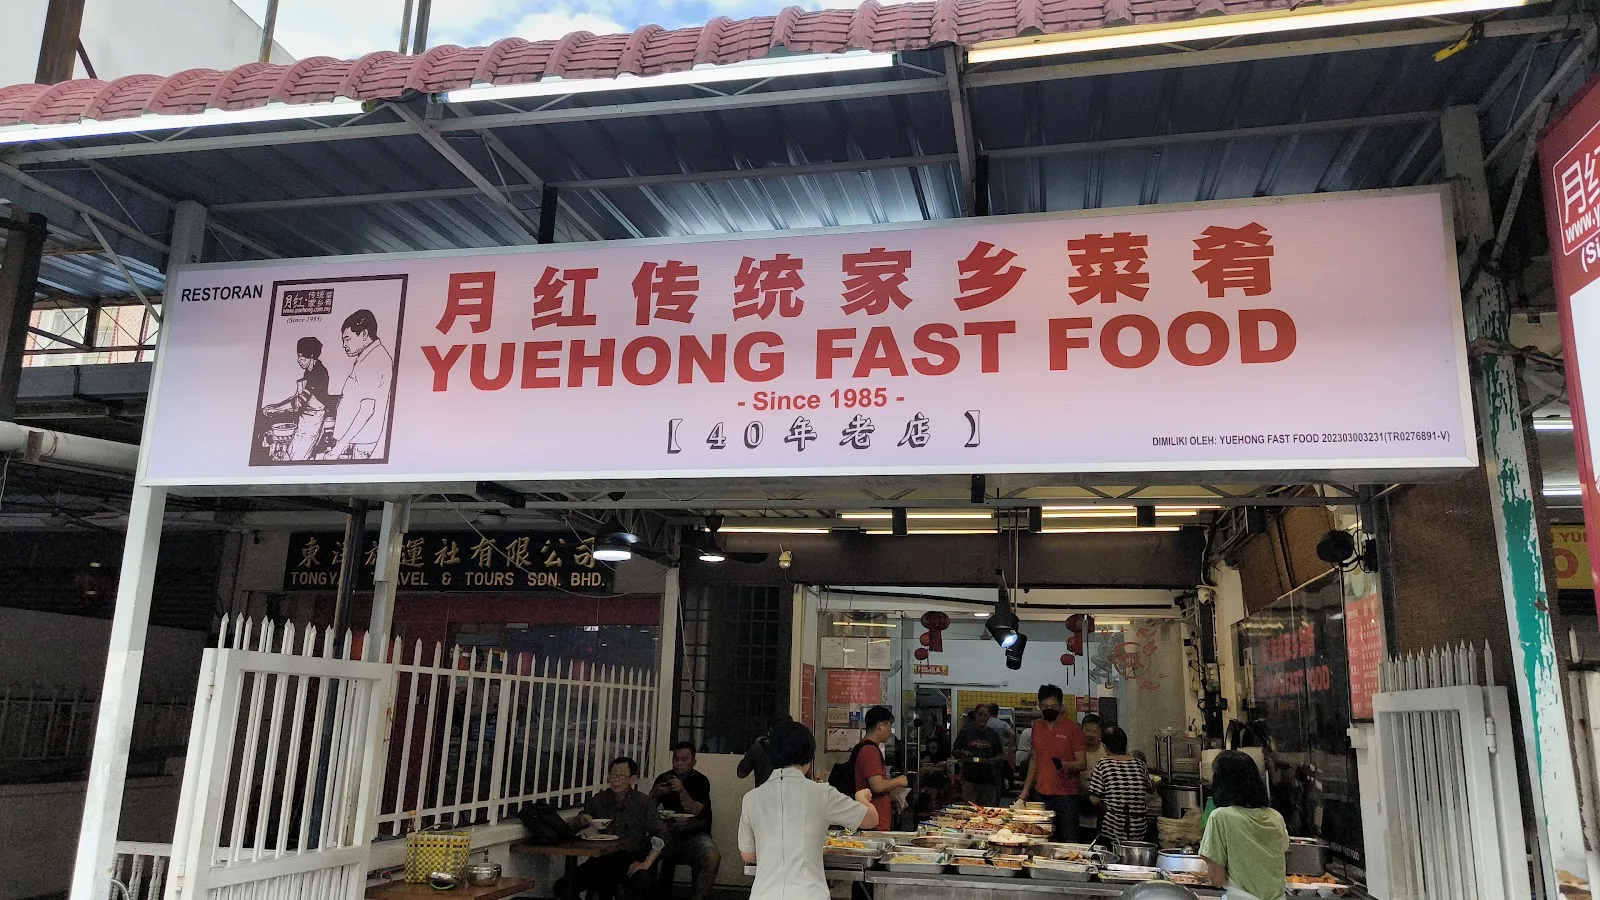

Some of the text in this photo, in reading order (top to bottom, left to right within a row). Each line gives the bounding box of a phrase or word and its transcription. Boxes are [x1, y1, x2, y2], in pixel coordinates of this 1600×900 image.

[435, 221, 1275, 336] 月红传统家乡菜肴
[181, 284, 264, 303] RESTORAN
[420, 308, 1297, 392] YUEHONG FAST FOOD
[752, 391, 821, 411] Since
[829, 387, 888, 409] 1985
[1152, 436, 1188, 446] DIMILIKI
[1189, 435, 1217, 446] OLEH:
[1219, 434, 1265, 445] YUEHONG
[1267, 434, 1290, 444] FAST
[1292, 433, 1320, 443] FOOD
[291, 571, 340, 586] TONGY
[441, 572, 452, 586] &
[464, 571, 514, 586] TOURS
[527, 572, 562, 587] SDN.
[570, 572, 606, 587] BHD.
